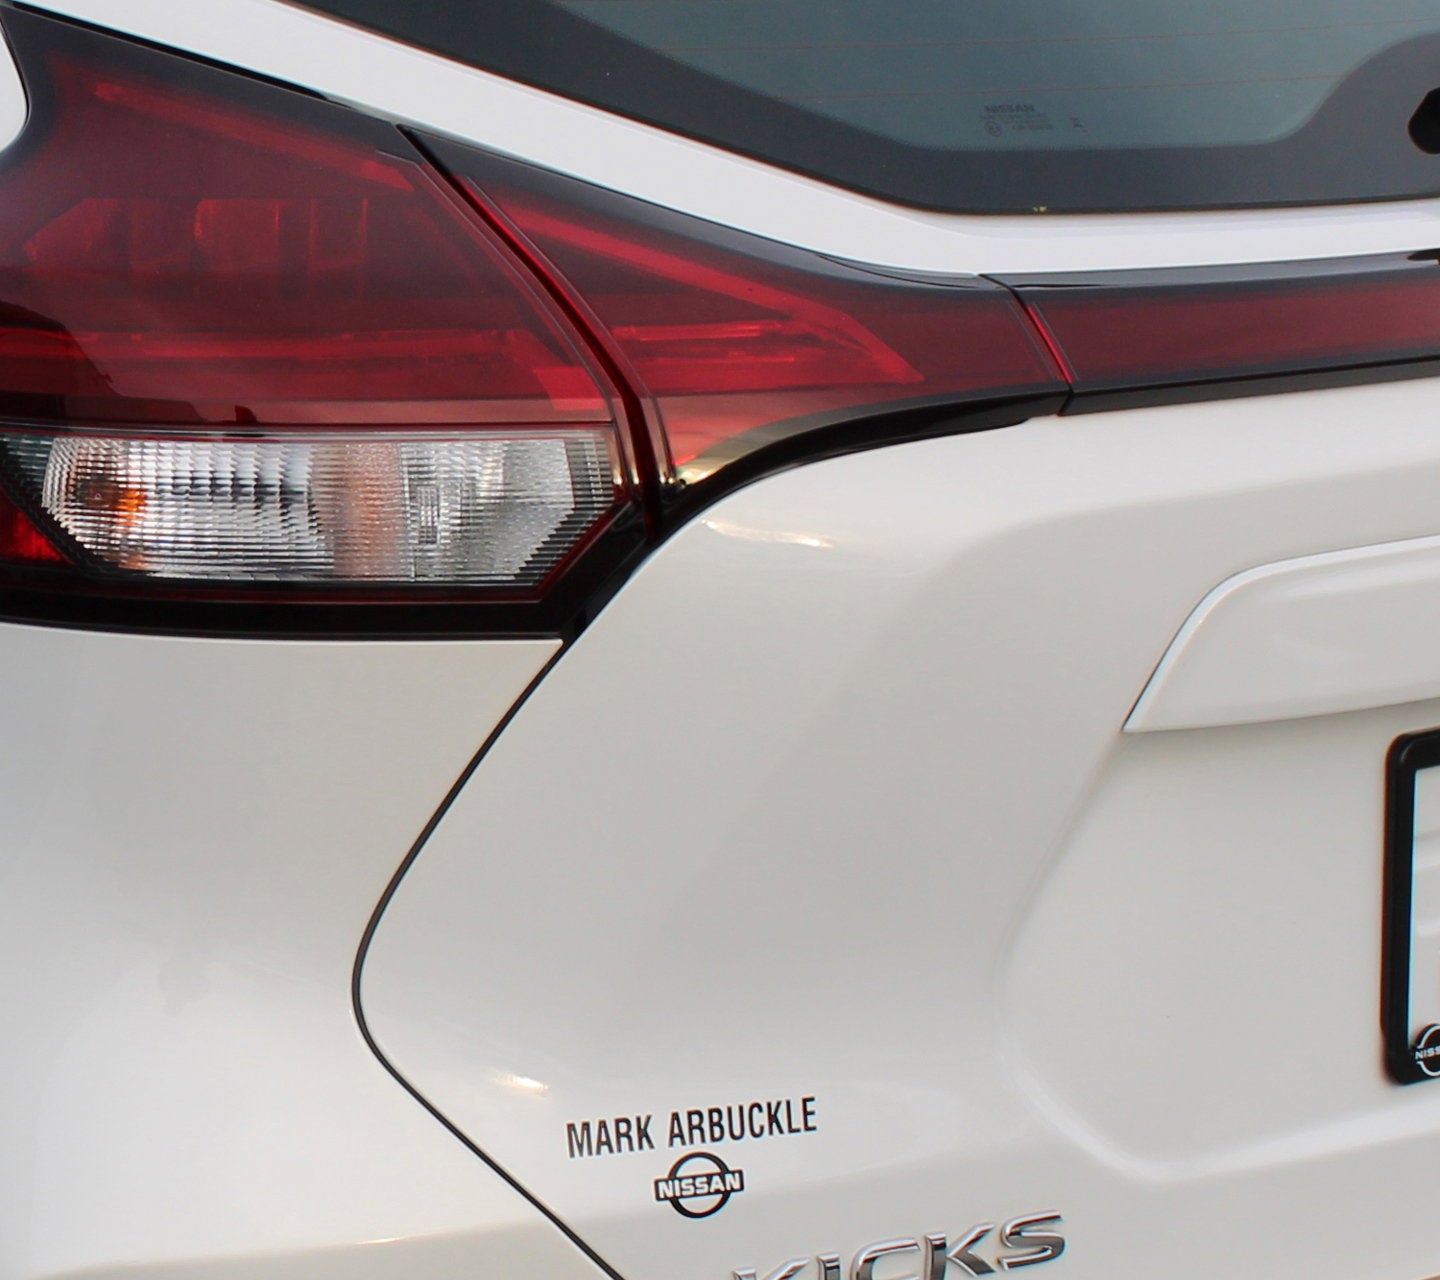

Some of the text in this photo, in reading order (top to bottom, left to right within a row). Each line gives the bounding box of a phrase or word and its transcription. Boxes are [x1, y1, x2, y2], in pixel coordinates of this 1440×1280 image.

[566, 1096, 818, 1158] MARK ARBUCKLE
[658, 1172, 741, 1198] NISSAN
